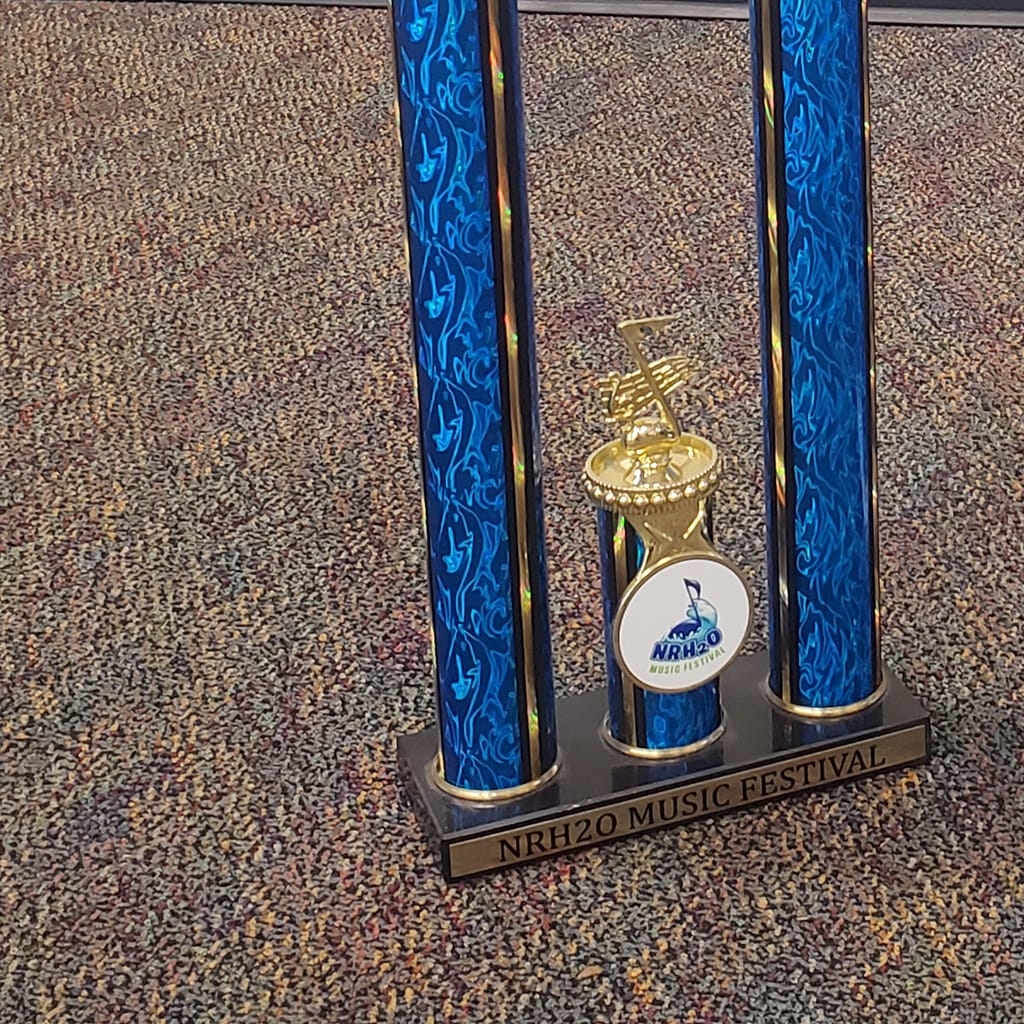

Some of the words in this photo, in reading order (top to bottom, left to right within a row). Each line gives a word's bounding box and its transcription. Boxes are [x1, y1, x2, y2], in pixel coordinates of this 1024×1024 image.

[649, 663, 681, 675] MUSIC
[683, 647, 726, 672] FESTIVAL
[628, 783, 731, 830] MUSIC
[741, 744, 886, 799] FESTIVAL
